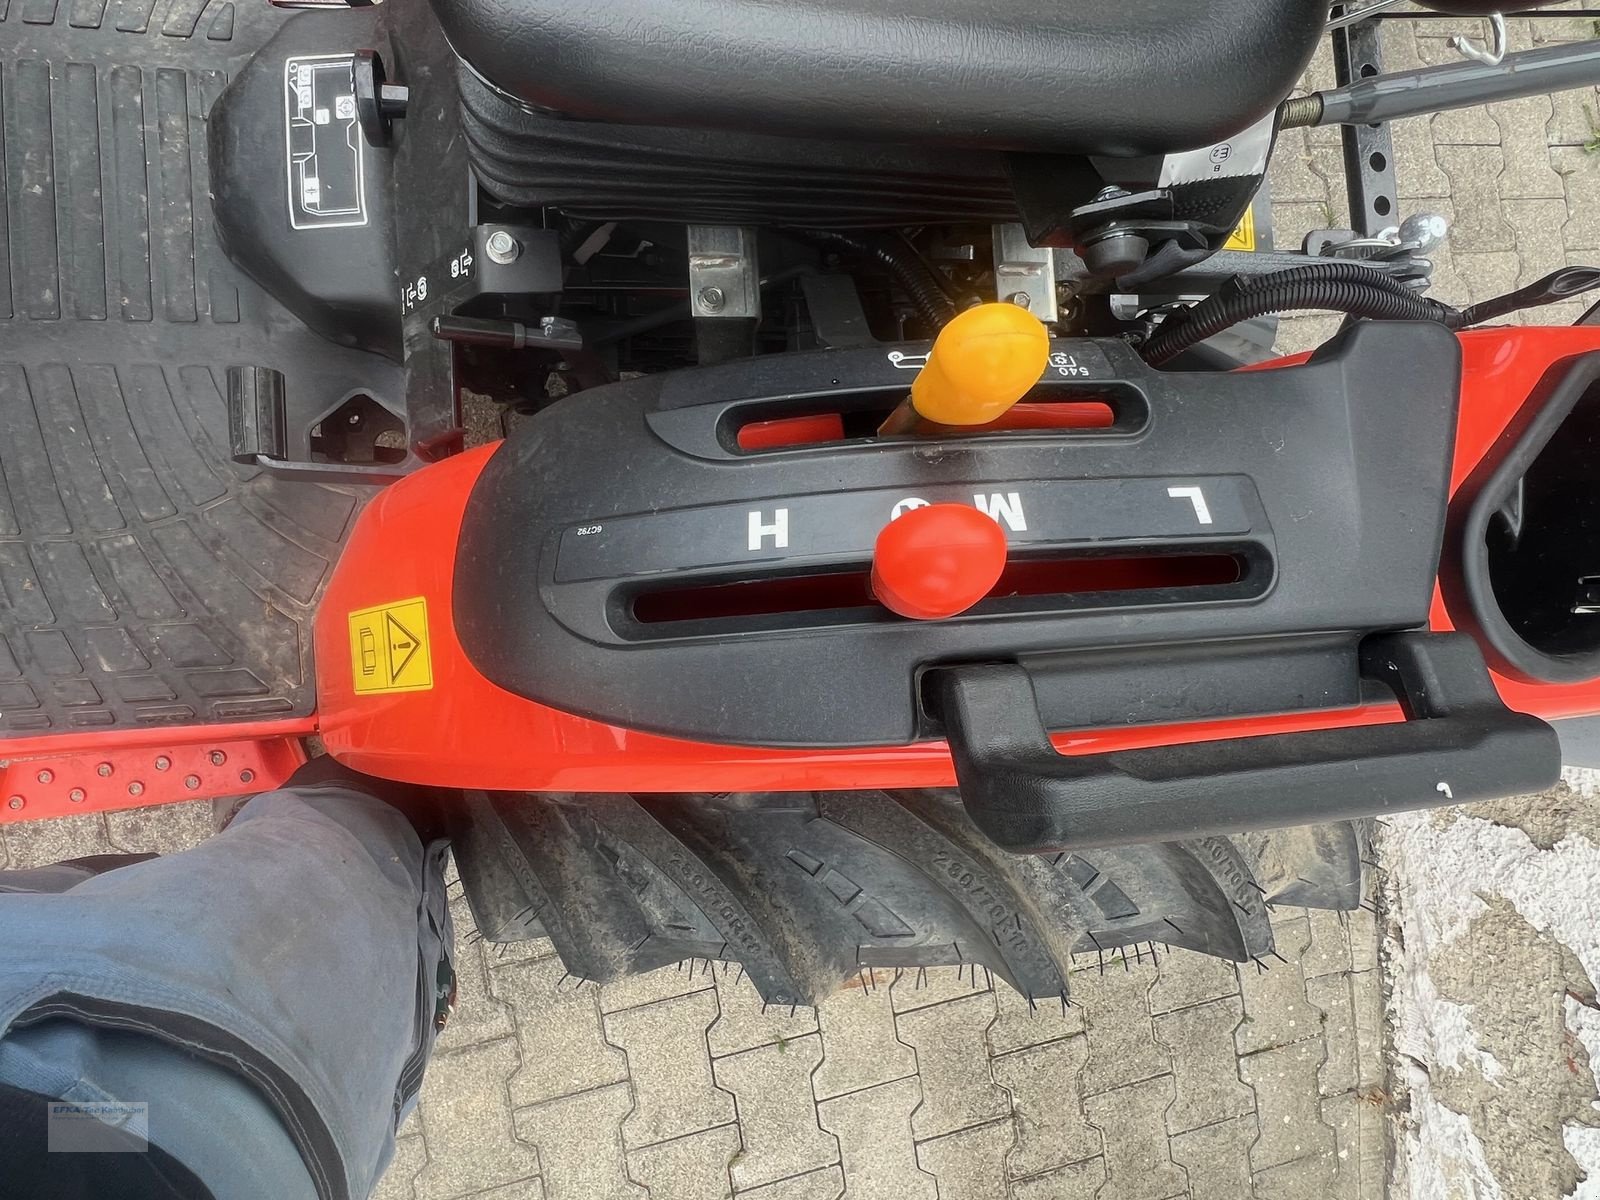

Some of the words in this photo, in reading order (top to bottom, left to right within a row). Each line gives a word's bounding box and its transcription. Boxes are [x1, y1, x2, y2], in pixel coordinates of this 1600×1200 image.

[1058, 366, 1089, 376] 540
[973, 492, 1027, 531] M
[1167, 487, 1212, 524] L
[576, 525, 603, 536] 6C792
[748, 508, 788, 551] H
